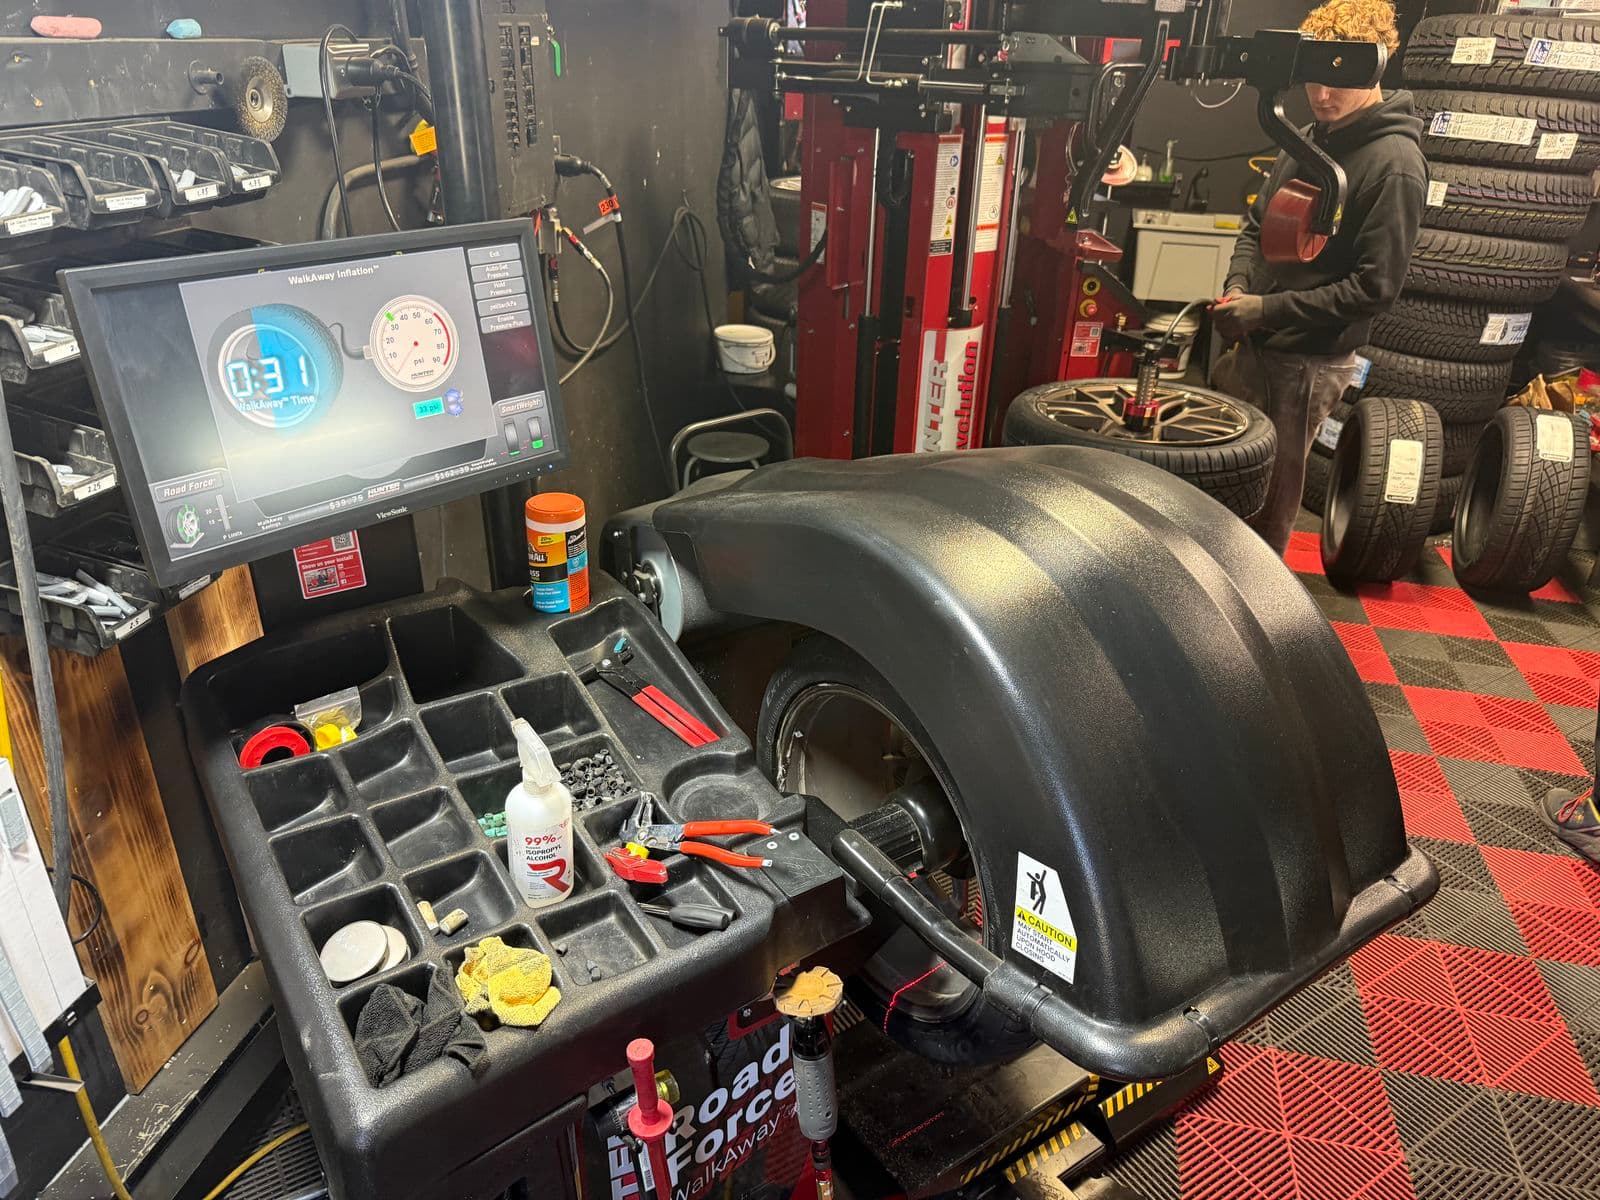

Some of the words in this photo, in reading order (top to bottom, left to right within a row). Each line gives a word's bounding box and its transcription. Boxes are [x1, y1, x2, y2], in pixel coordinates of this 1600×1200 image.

[600, 199, 614, 213] 230
[288, 269, 335, 285] WalkAway
[413, 357, 425, 366] psi
[433, 356, 441, 364] 90
[227, 355, 309, 398] 0:31
[289, 394, 316, 406] Time
[164, 483, 187, 498] Road
[367, 481, 401, 496] HUNTER
[375, 506, 409, 520] ViewSonic
[525, 834, 557, 845] 99%
[526, 844, 562, 856] ISOPROPYL
[526, 853, 557, 862] ALCOHOL
[1017, 920, 1031, 933] MAY
[1032, 929, 1053, 946] START
[1028, 915, 1072, 948] CAUTION
[1015, 941, 1045, 963] CLOSING
[1016, 927, 1071, 963] AUTOMATICALLY
[1016, 934, 1036, 950] UPON
[1036, 946, 1056, 962] HOOD
[664, 1023, 790, 1151] Road
[666, 1068, 797, 1188] Force
